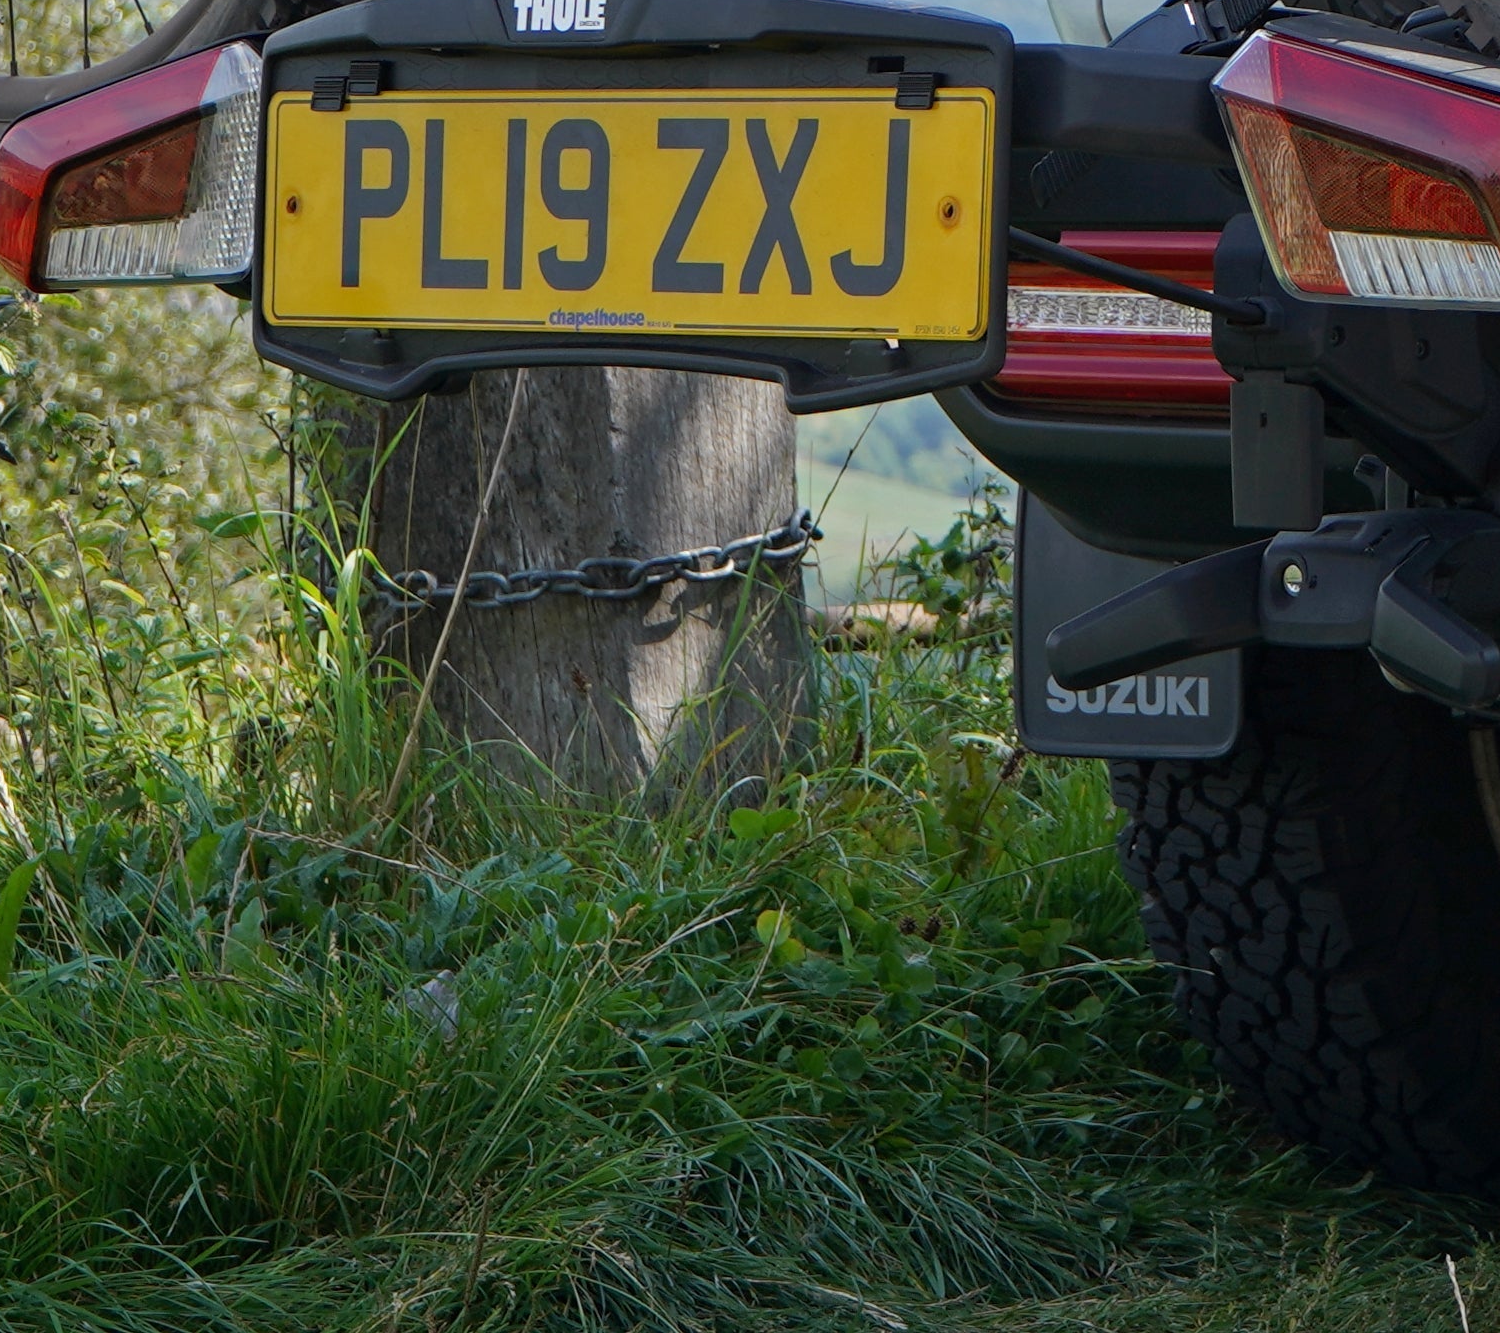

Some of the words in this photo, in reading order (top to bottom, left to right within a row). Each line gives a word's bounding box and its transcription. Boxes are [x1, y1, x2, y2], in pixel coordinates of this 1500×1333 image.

[341, 117, 611, 292] PL19
[651, 117, 911, 298] ZXJ
[549, 306, 645, 332] chapelhouse
[1046, 674, 1210, 717] SUZUKI
